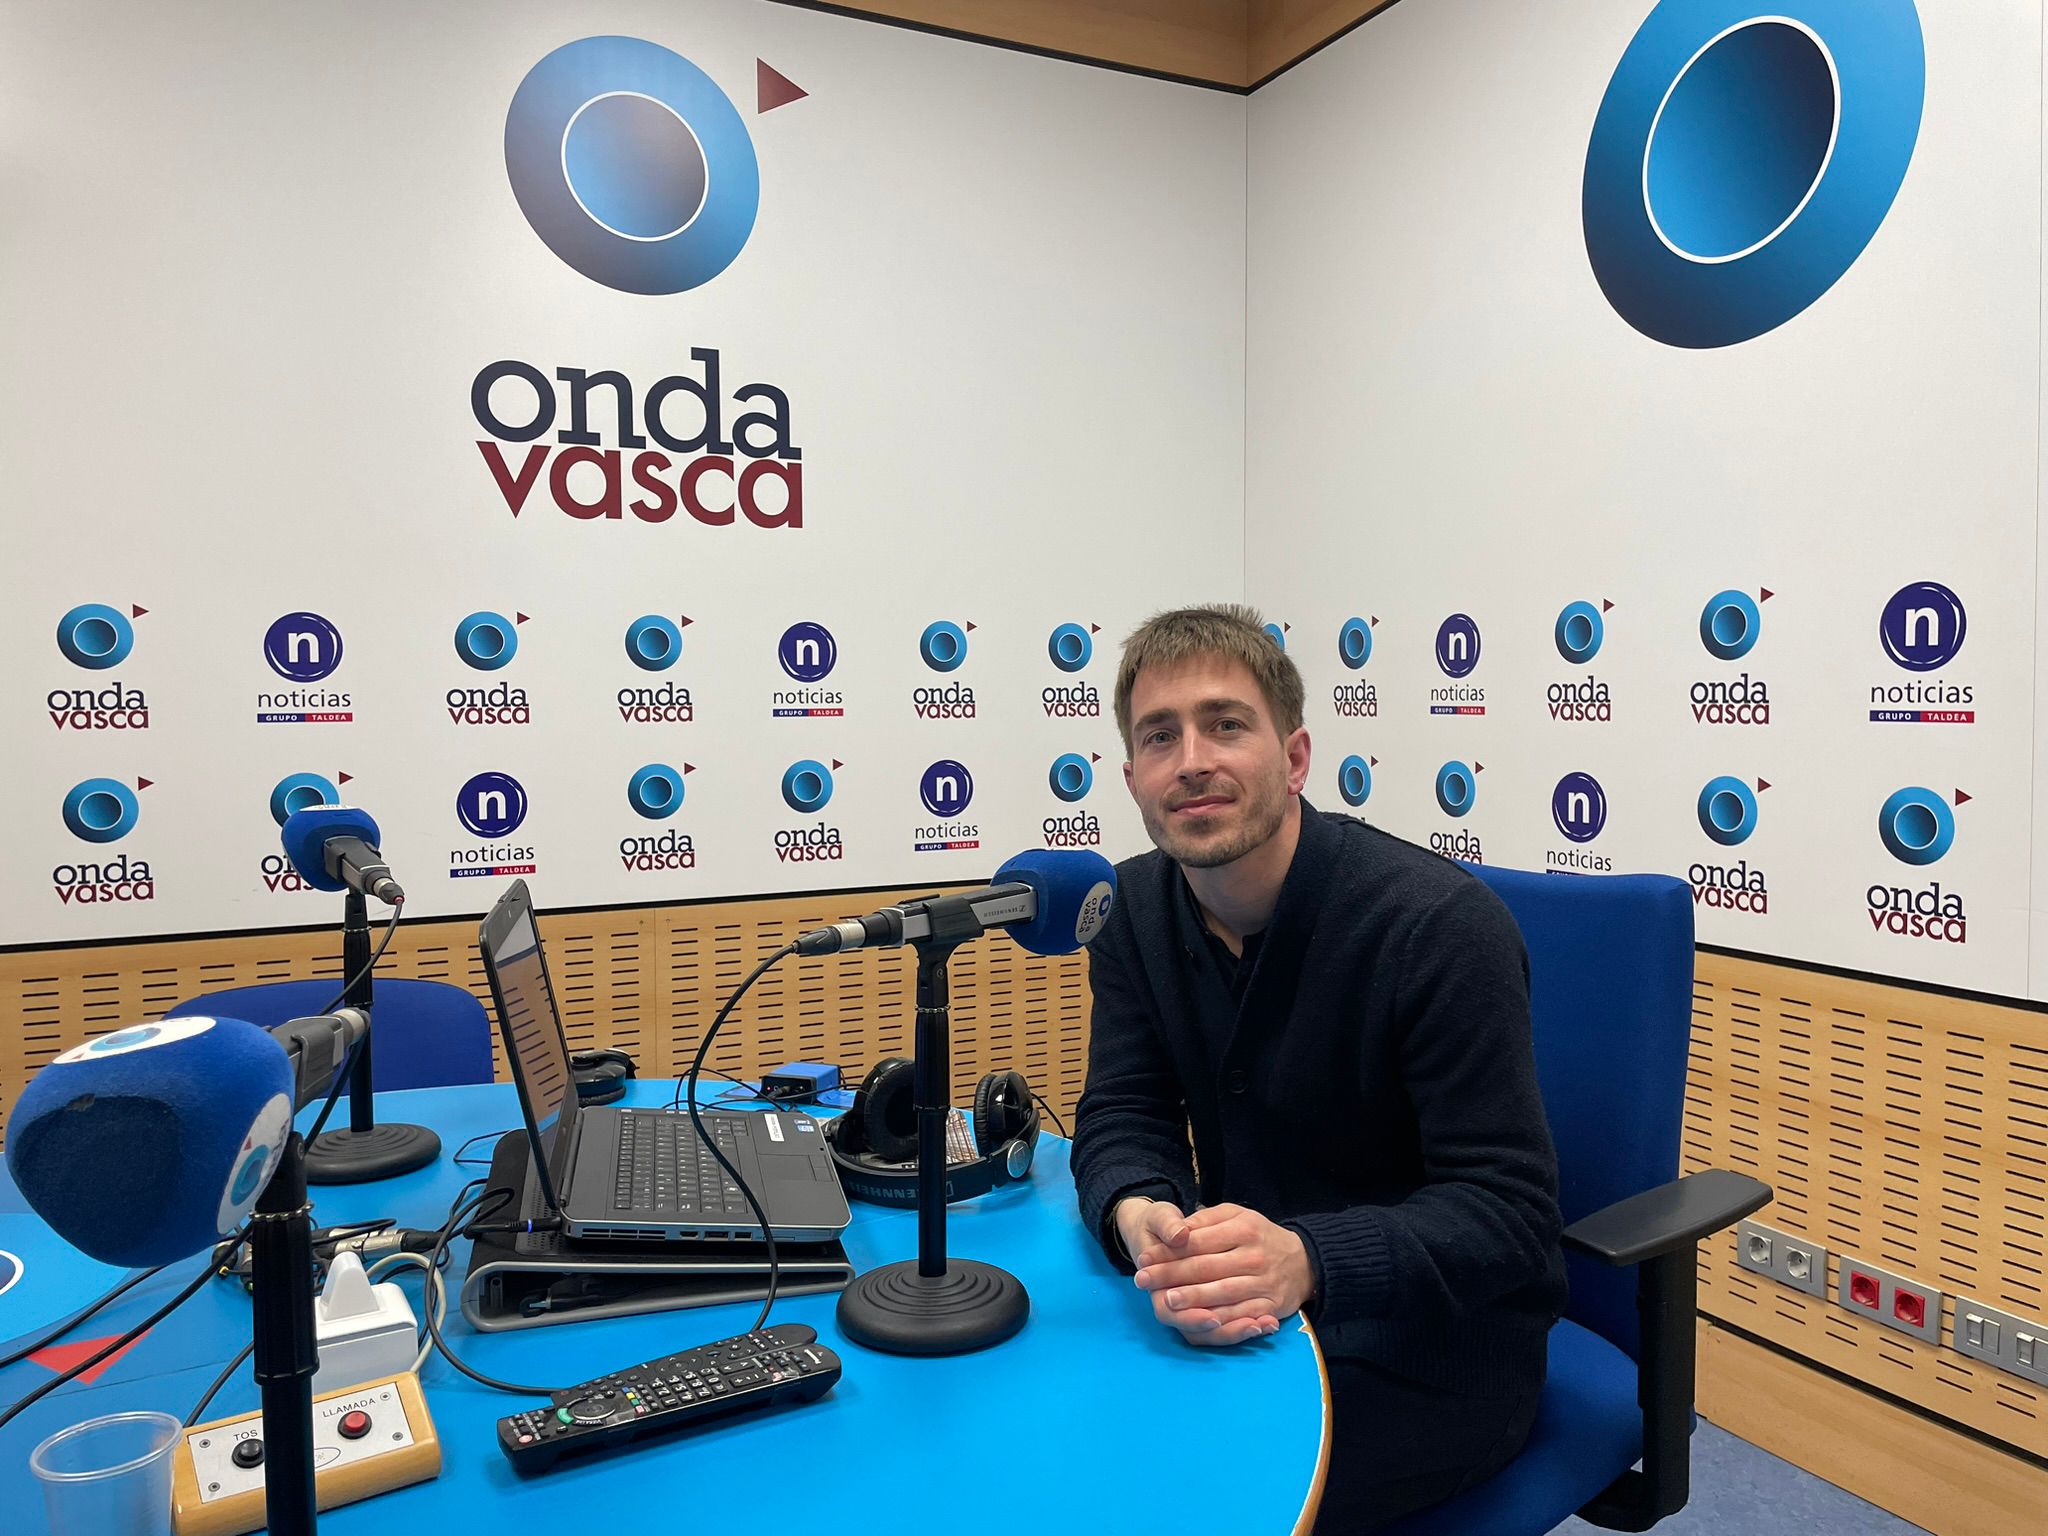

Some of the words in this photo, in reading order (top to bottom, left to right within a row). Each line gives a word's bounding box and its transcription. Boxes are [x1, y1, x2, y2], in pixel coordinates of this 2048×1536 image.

[471, 347, 803, 460] onda
[476, 441, 804, 529] vasca
[1906, 607, 1939, 647] n
[287, 631, 320, 663] n
[796, 638, 820, 665] n
[1449, 631, 1467, 660] n
[47, 682, 149, 711] onda
[257, 689, 352, 708] noticias
[446, 682, 529, 707] onda
[617, 681, 693, 706] onda
[773, 688, 843, 704] noticias
[913, 682, 975, 705] onda
[1042, 681, 1099, 704] onda
[1334, 679, 1377, 702] onda
[1431, 684, 1485, 701] noticias
[1547, 675, 1611, 702] onda
[1690, 673, 1769, 704] onda
[1871, 680, 1974, 703] noticias
[50, 708, 149, 730] vasca
[448, 705, 530, 725] vasca
[620, 704, 693, 722] vasca
[914, 703, 976, 719] vasca
[1044, 702, 1100, 717] vasca
[1334, 700, 1377, 717] vasca
[1548, 701, 1611, 721] vasca
[1691, 702, 1770, 725] vasca
[1878, 712, 1912, 720] GRUPO
[1927, 713, 1967, 721] TALDEA
[936, 773, 957, 802] n
[478, 790, 507, 820] n
[1568, 792, 1590, 823] n
[914, 822, 979, 839] noticias
[1043, 811, 1101, 833] onda
[620, 829, 695, 857] onda
[774, 822, 842, 848] onda
[1044, 831, 1101, 846] vasca
[1430, 829, 1482, 855] onda
[450, 843, 535, 863] noticias
[623, 851, 695, 872] vasca
[776, 843, 843, 862] vasca
[1546, 849, 1612, 872] noticias
[53, 854, 153, 885] onda
[457, 868, 487, 876] GRUPO
[499, 866, 531, 874] TALDEA
[1689, 860, 1767, 893] onda
[55, 880, 154, 904] vasca
[1691, 885, 1767, 914] vasca
[1867, 882, 1966, 920] onda
[1868, 907, 1967, 943] vasca
[323, 1398, 376, 1418] LLAMADA
[233, 1429, 258, 1441] TOS
